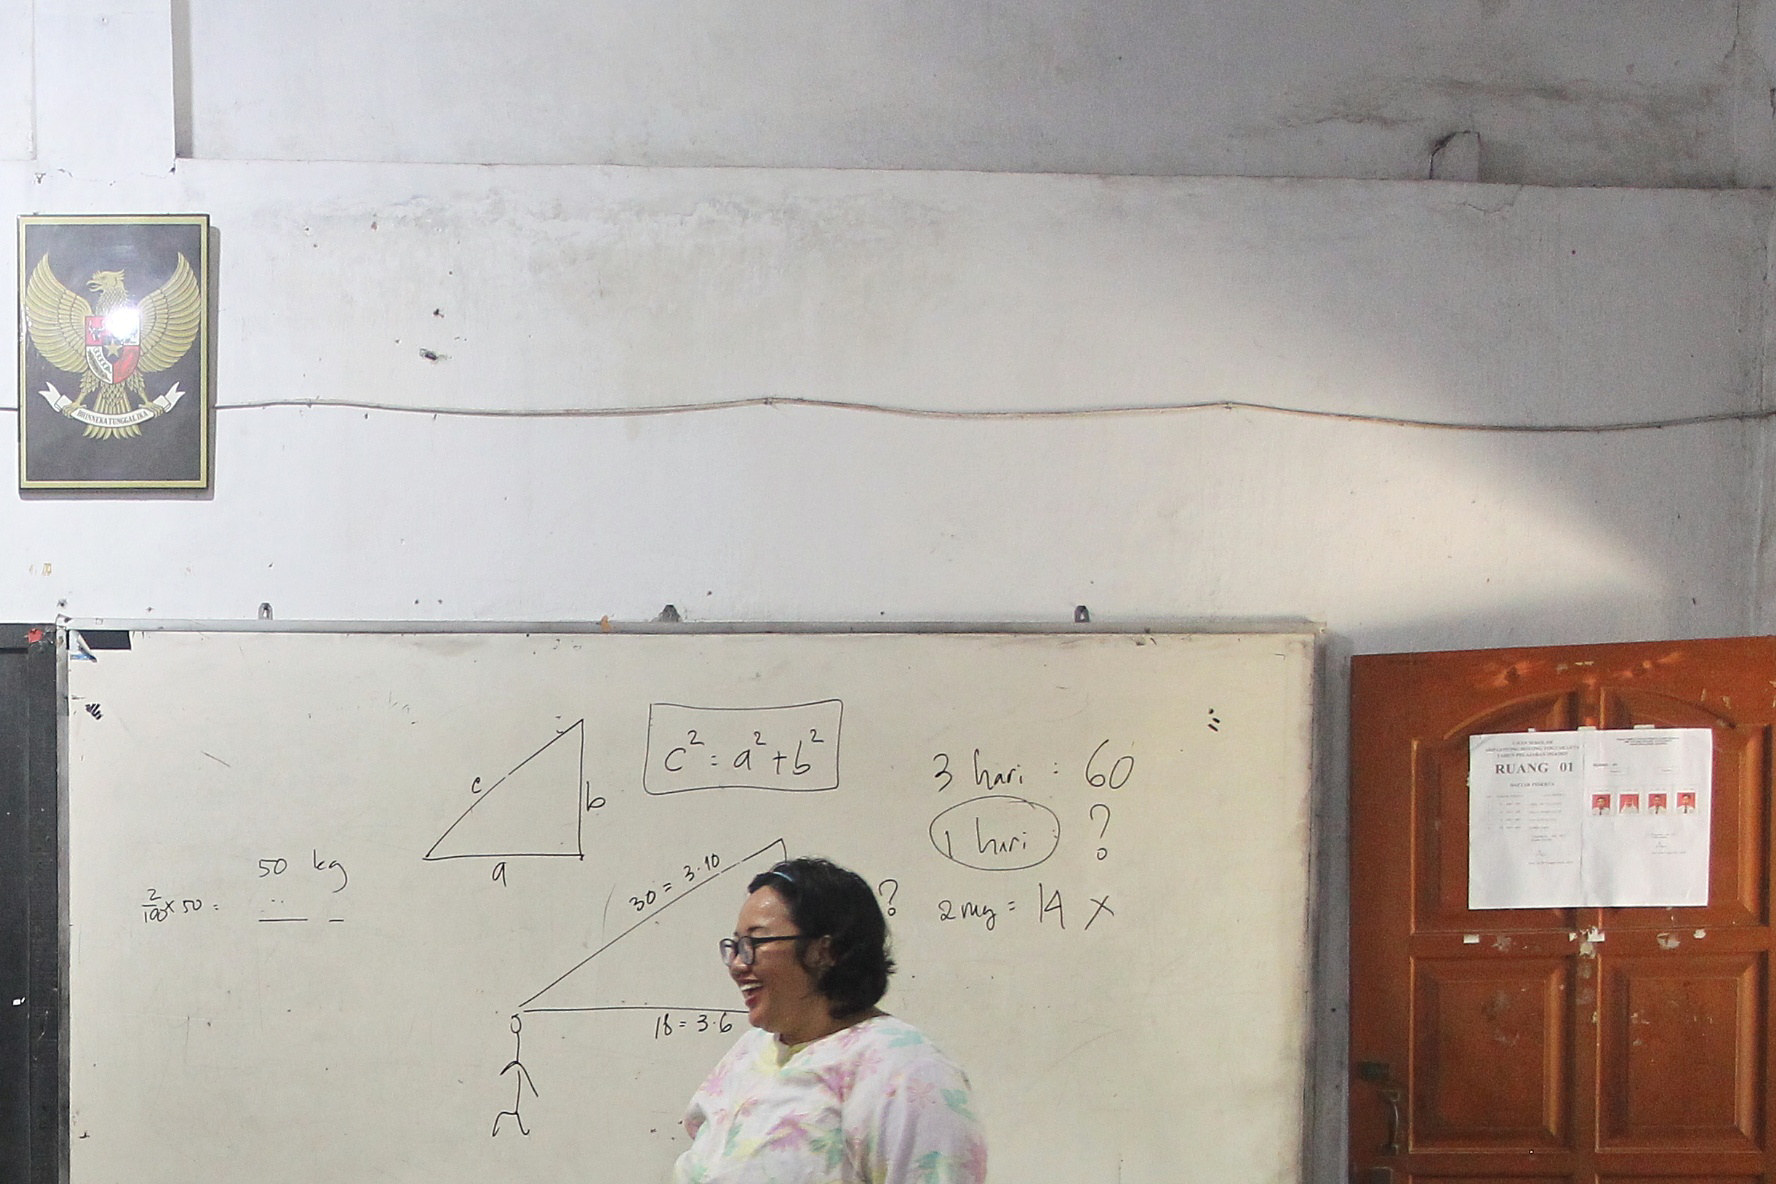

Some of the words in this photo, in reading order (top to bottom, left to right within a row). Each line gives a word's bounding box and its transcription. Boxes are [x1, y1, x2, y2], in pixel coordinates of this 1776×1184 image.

[933, 753, 953, 792] 3
[973, 748, 1023, 791] hari
[1086, 739, 1135, 789] 60
[1495, 762, 1549, 774] RUANG
[1559, 762, 1574, 772] 01
[1090, 803, 1111, 861] ?
[258, 858, 288, 878] 50
[313, 849, 348, 894] kg
[147, 888, 162, 901] 2
[182, 899, 203, 914] 50
[629, 890, 657, 911] 30
[878, 878, 899, 917] ?
[1038, 882, 1066, 930] 14
[654, 1012, 673, 1040] 18
